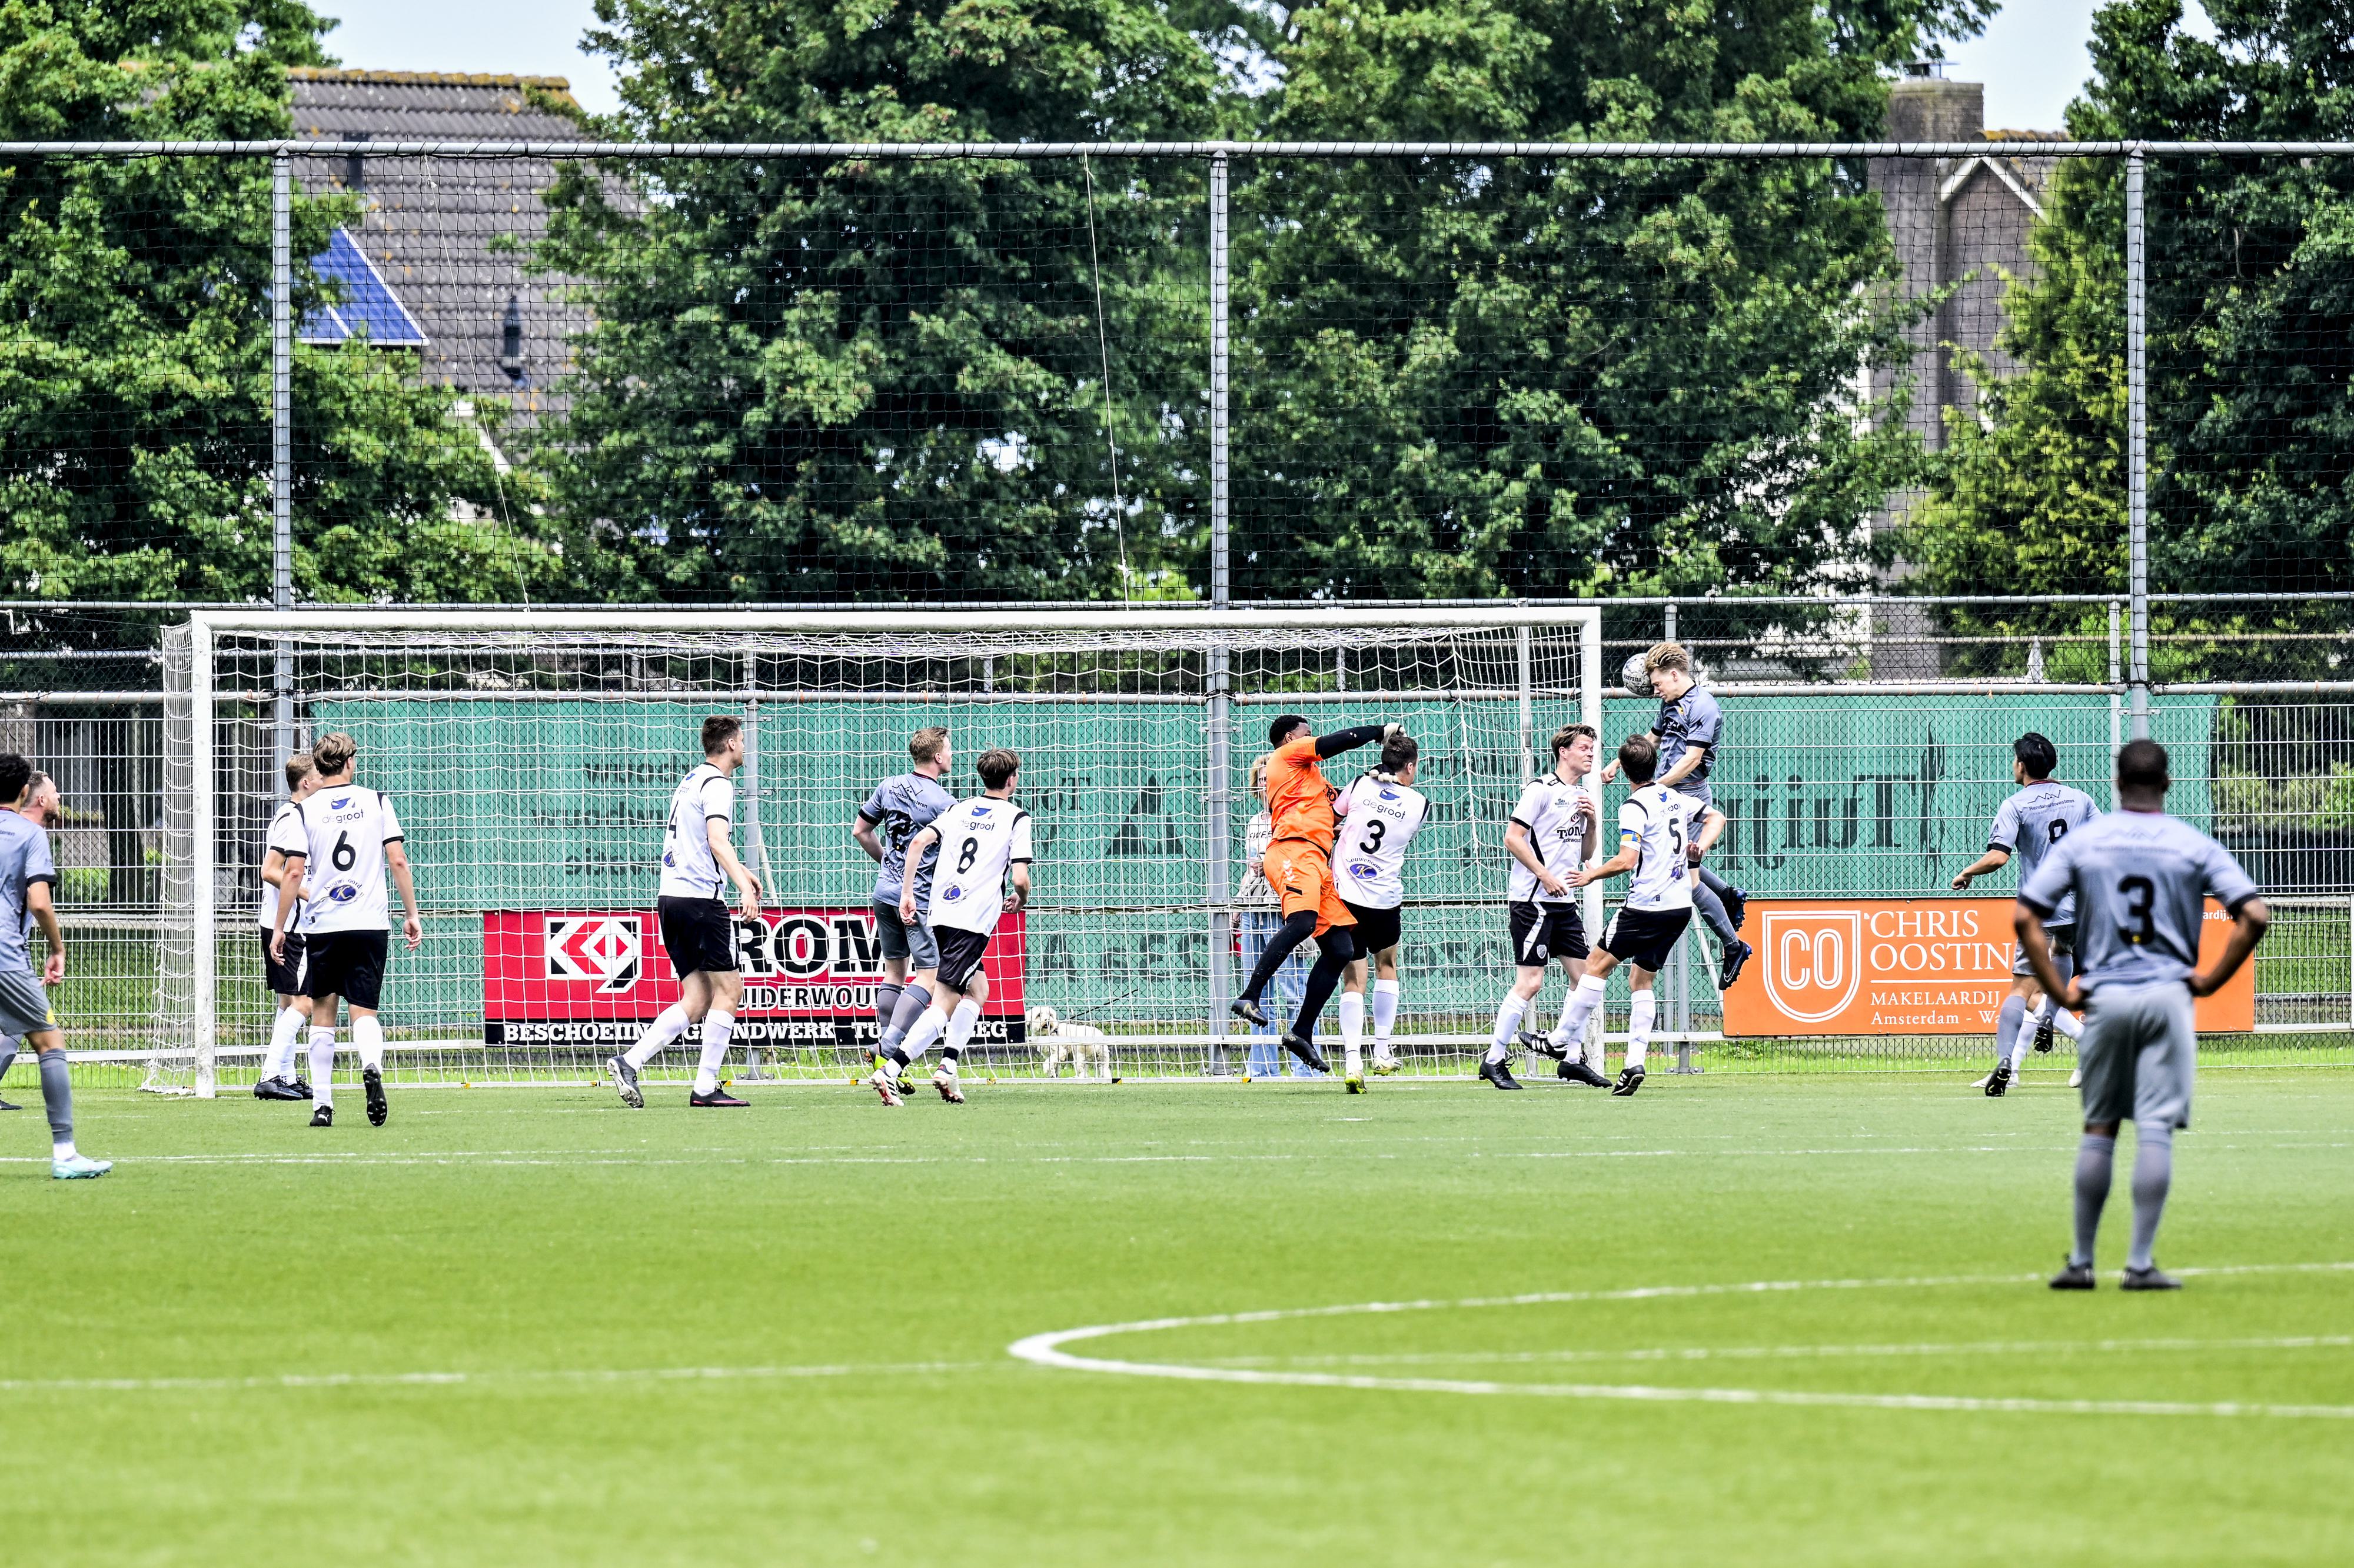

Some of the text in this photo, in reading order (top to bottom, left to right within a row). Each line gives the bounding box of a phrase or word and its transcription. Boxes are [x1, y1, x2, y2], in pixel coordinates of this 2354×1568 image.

[332, 830, 356, 872] 6
[1359, 819, 1386, 855] 3
[1668, 817, 1682, 855] 5
[956, 837, 978, 875] 8
[1870, 910, 1979, 938] CHRIS
[2117, 874, 2156, 946] 3
[1780, 928, 1844, 990] CO
[1870, 943, 2013, 971] OOSTIN
[1870, 991, 2000, 1008] MAKELAARDIJ
[1870, 1010, 1960, 1025] Amsterdam
[504, 1023, 652, 1041] BESCHOEIIN
